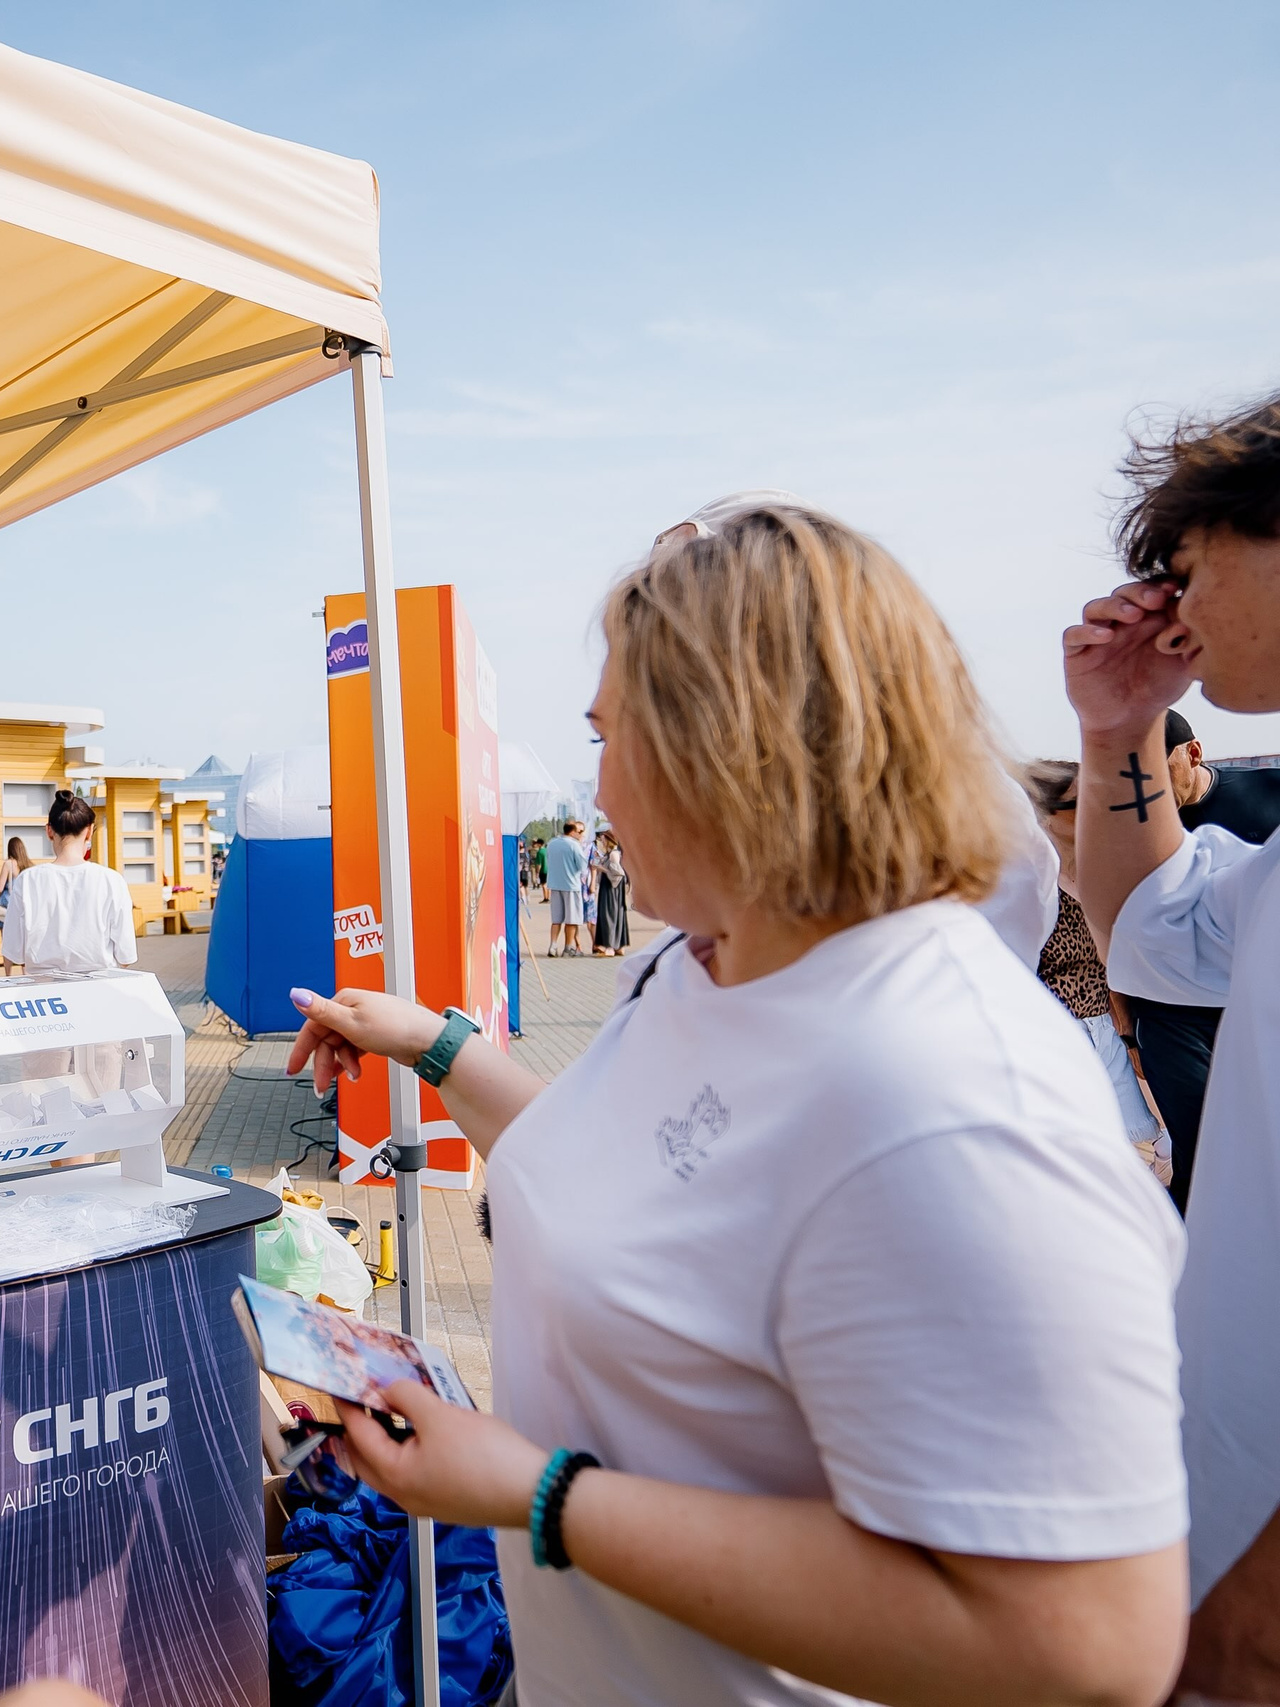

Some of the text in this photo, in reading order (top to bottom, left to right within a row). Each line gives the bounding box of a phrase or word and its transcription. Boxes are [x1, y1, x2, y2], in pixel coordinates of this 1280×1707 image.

[0, 997, 68, 1020] СНГБ
[38, 1022, 75, 1034] ГОРОДА
[12, 1377, 170, 1465] СНГБ
[87, 1446, 171, 1491] ГОРОДА
